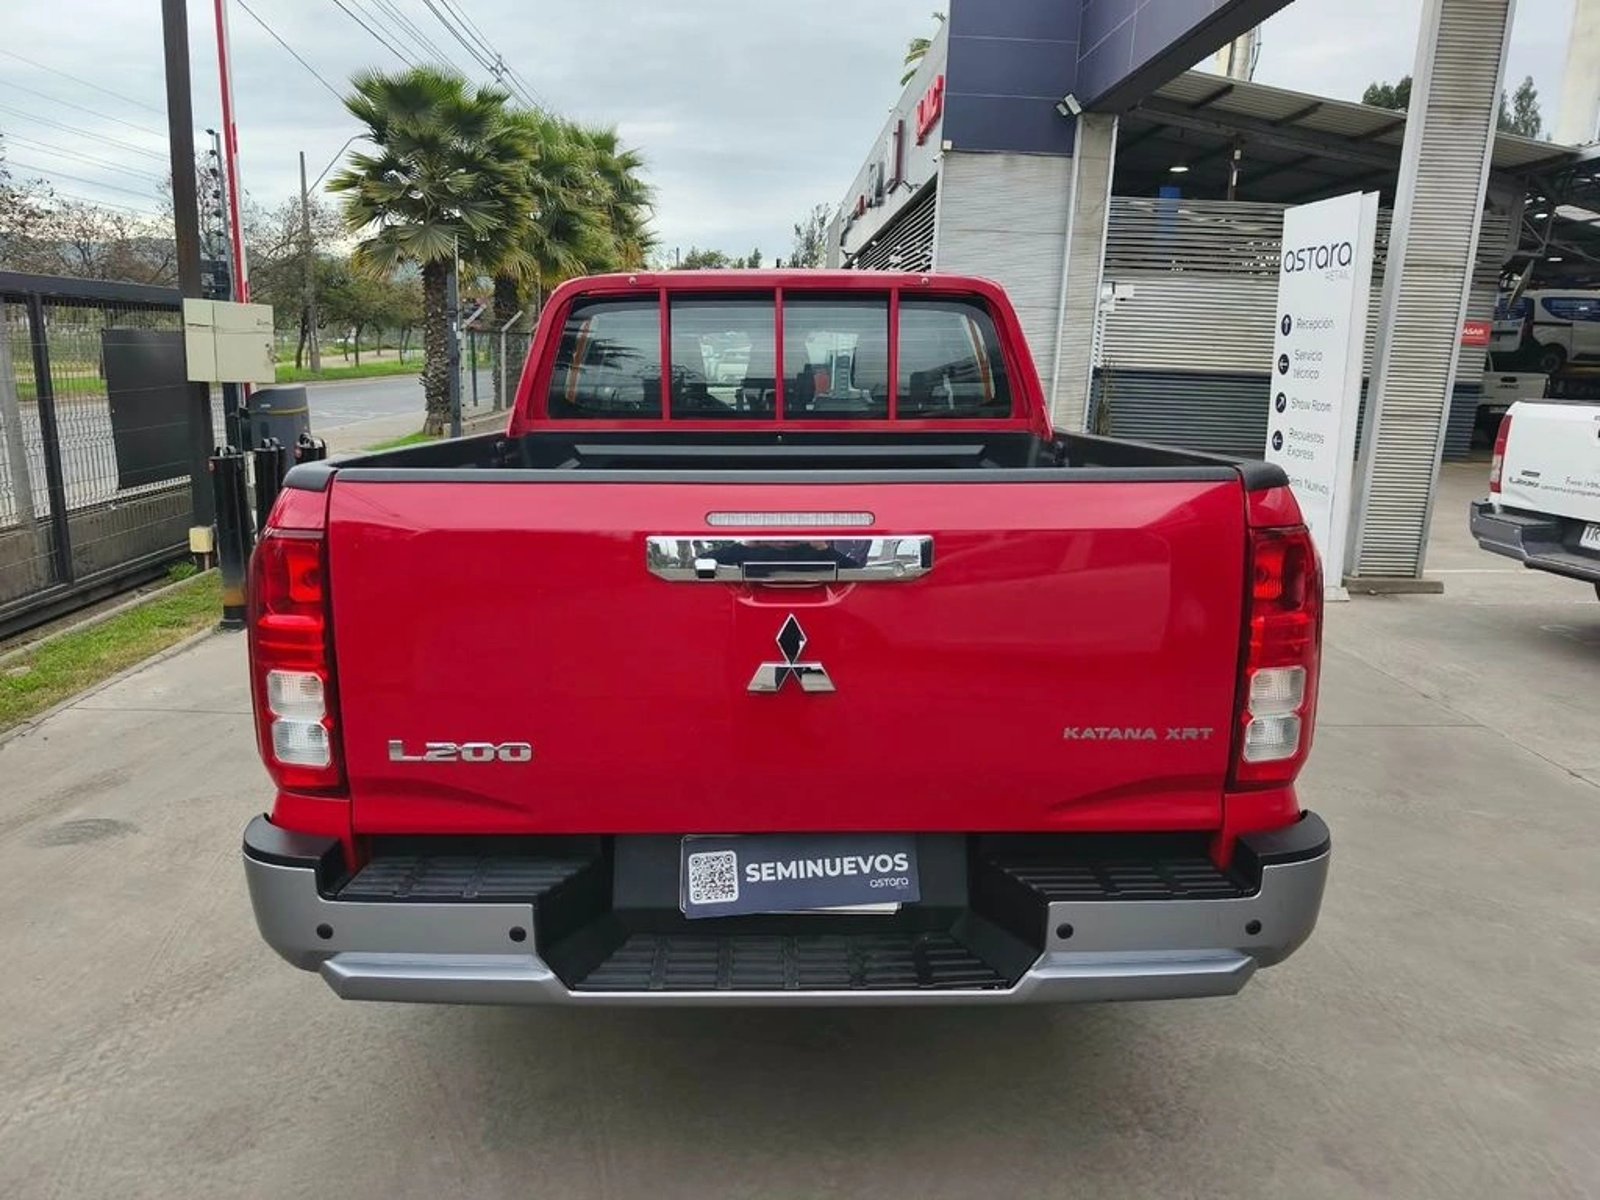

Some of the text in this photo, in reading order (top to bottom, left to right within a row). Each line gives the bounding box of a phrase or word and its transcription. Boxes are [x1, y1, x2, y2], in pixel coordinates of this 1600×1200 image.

[1283, 241, 1353, 273] astara
[1294, 349, 1323, 362] Servicio
[1291, 397, 1332, 412] Show Room
[1286, 445, 1314, 460] Express
[1062, 726, 1214, 741] KATANA XRT
[388, 739, 533, 763] L200
[745, 852, 909, 883] SEMINUEVOS
[869, 877, 909, 889] astara
